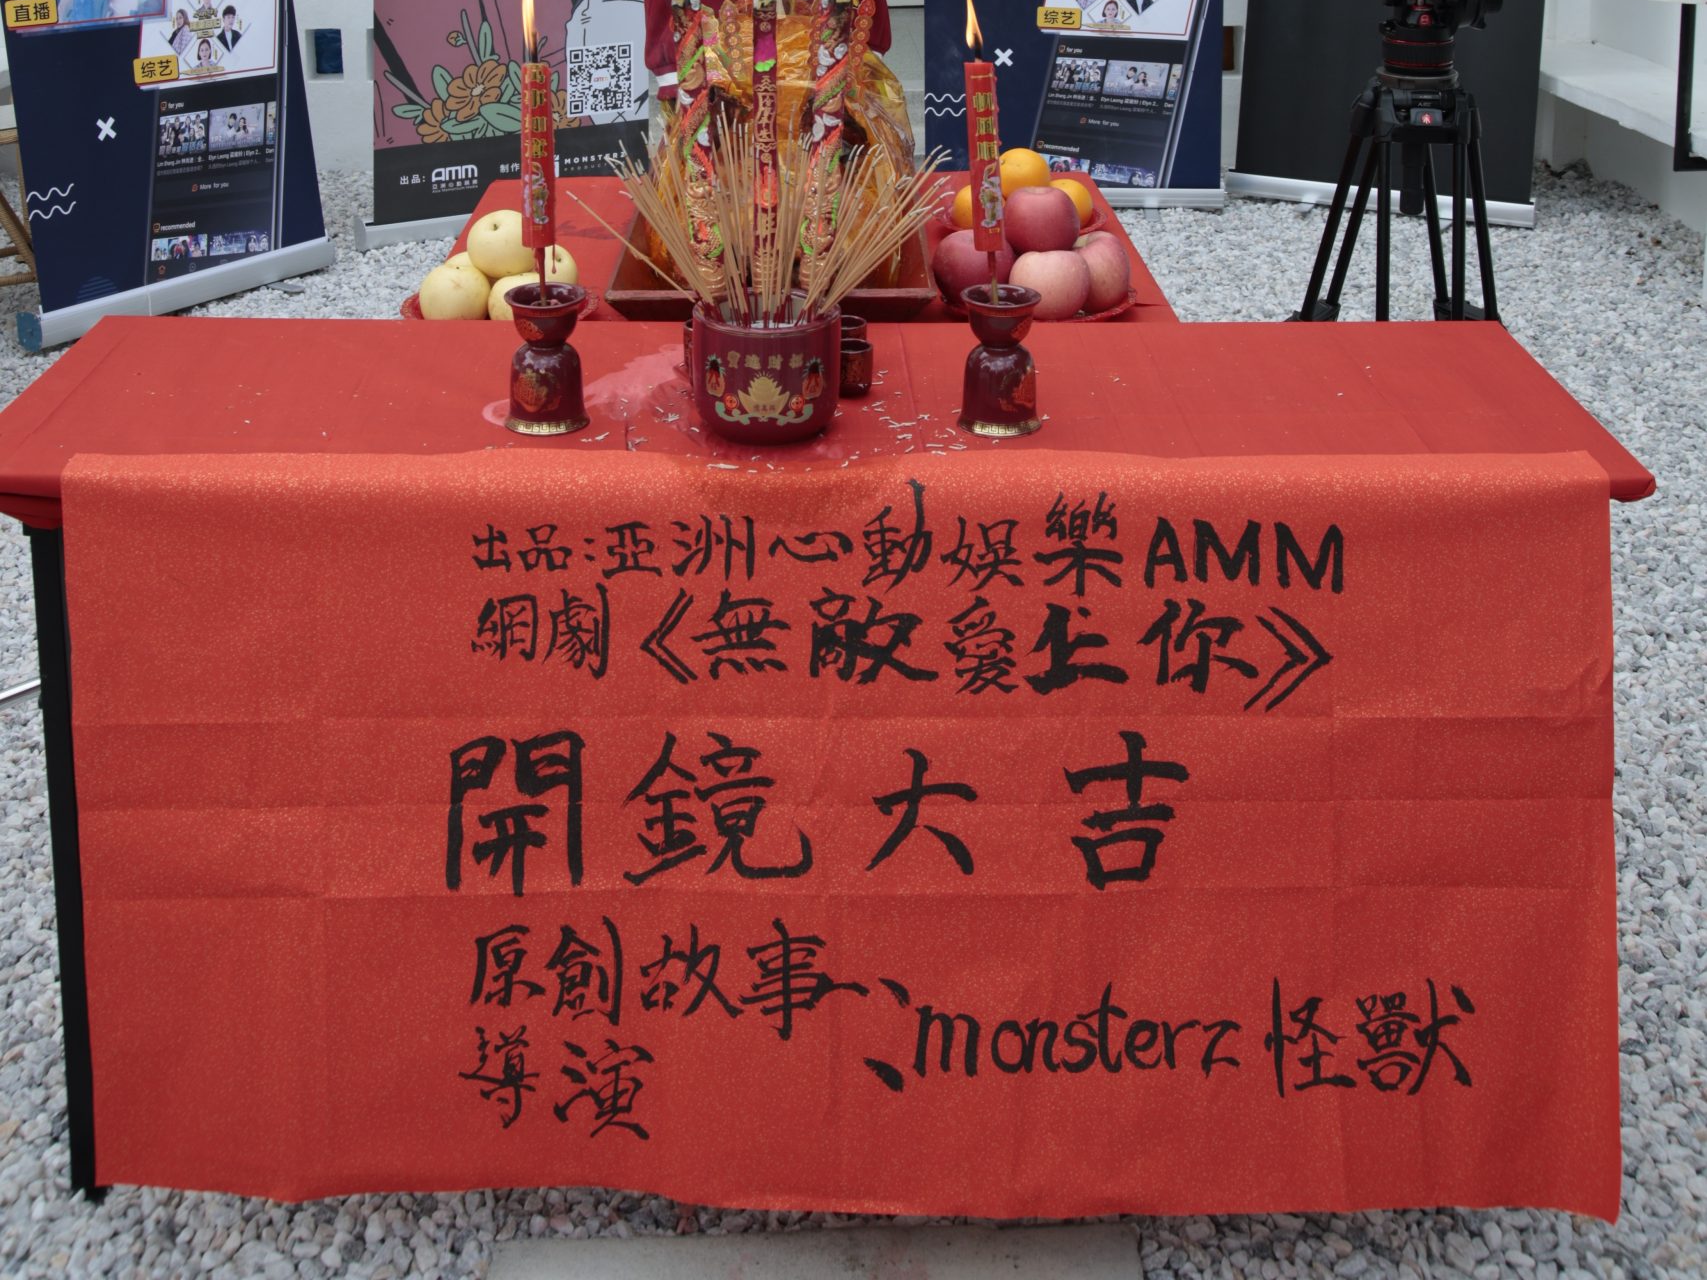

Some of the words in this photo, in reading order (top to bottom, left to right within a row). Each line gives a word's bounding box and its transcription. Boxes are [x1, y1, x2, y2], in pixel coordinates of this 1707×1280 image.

[13, 1, 51, 23] 直播
[1043, 10, 1075, 25] 综艺
[141, 59, 173, 78] 综艺
[1044, 143, 1080, 153] recommended
[500, 163, 521, 173] 制作
[400, 174, 426, 185] 出品:
[160, 221, 196, 232] recommended
[1144, 516, 1344, 594] AMM
[470, 917, 869, 1041] 原創故事
[1264, 978, 1475, 1098] 怪獸
[459, 1026, 653, 1140] 導演
